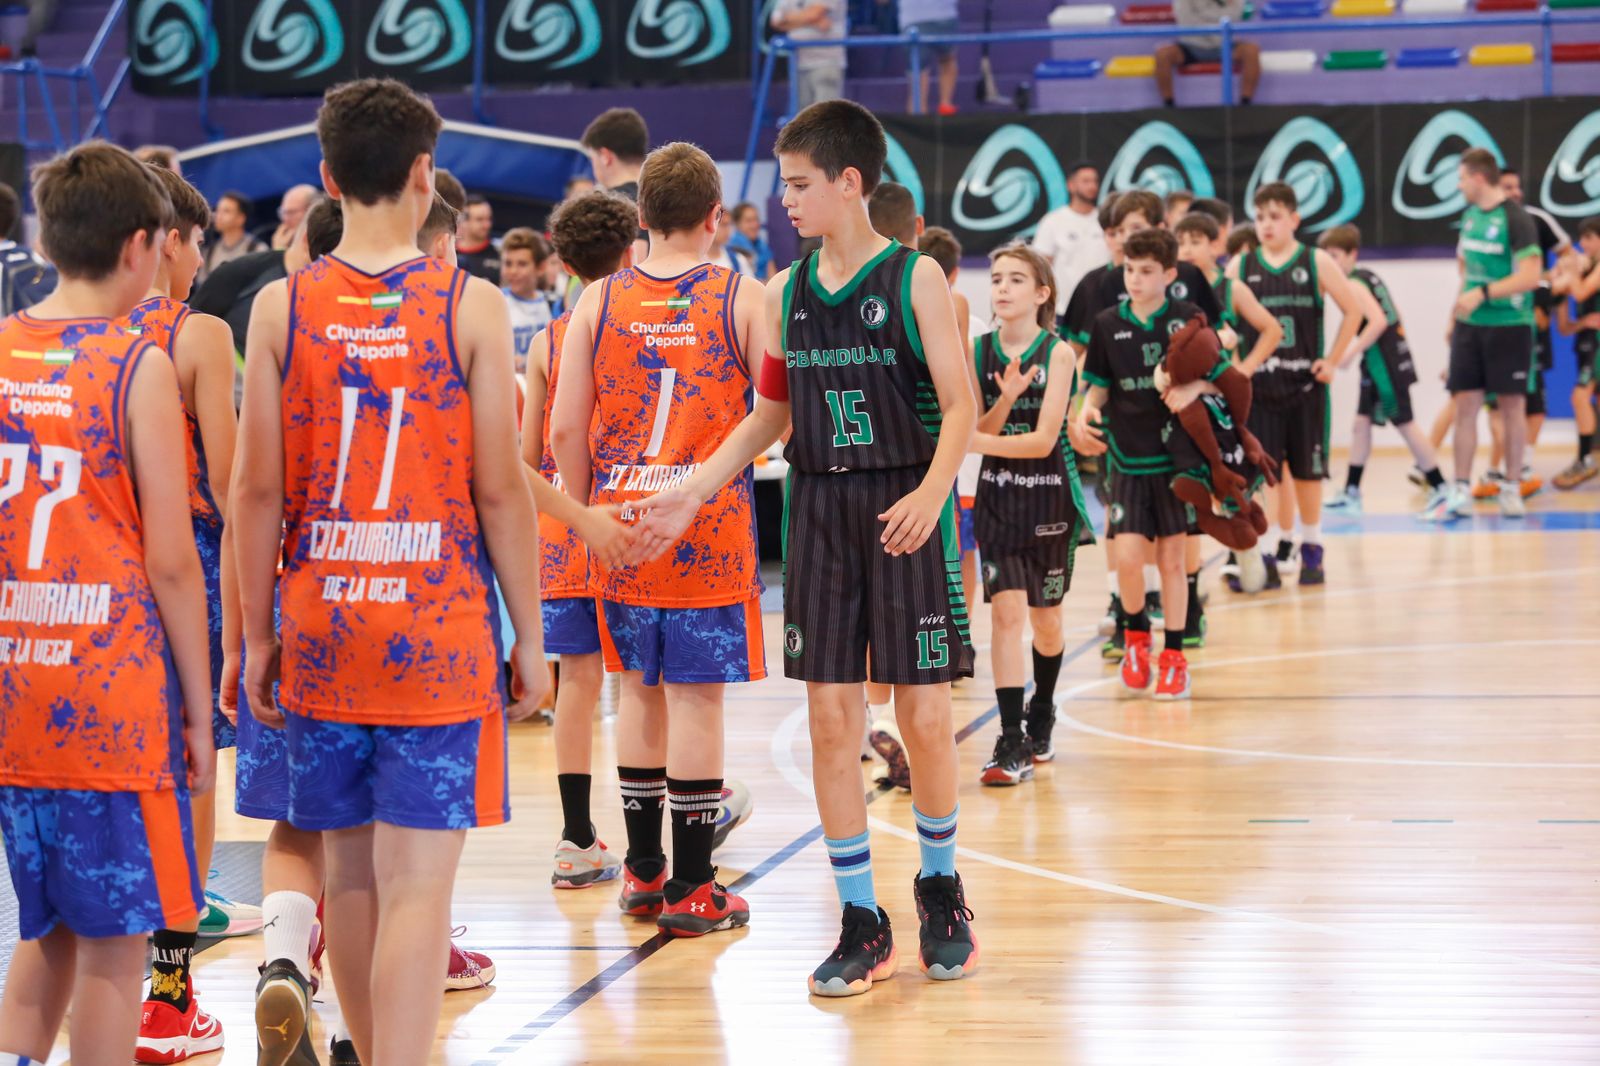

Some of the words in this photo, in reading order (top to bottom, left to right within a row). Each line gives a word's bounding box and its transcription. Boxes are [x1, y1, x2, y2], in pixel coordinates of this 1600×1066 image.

[325, 323, 406, 342] Churriana
[629, 321, 694, 334] Churriana
[346, 342, 409, 362] Deporte
[645, 335, 697, 349] Deporte
[10, 397, 73, 419] Deporte
[642, 367, 677, 457] 1
[825, 389, 874, 448] 15
[330, 386, 407, 510] 11
[1014, 473, 1062, 488] logistik
[322, 575, 346, 602] DE
[346, 576, 366, 603] LA
[15, 637, 31, 664] LA
[915, 629, 949, 670] 15
[686, 811, 718, 826] FIL
